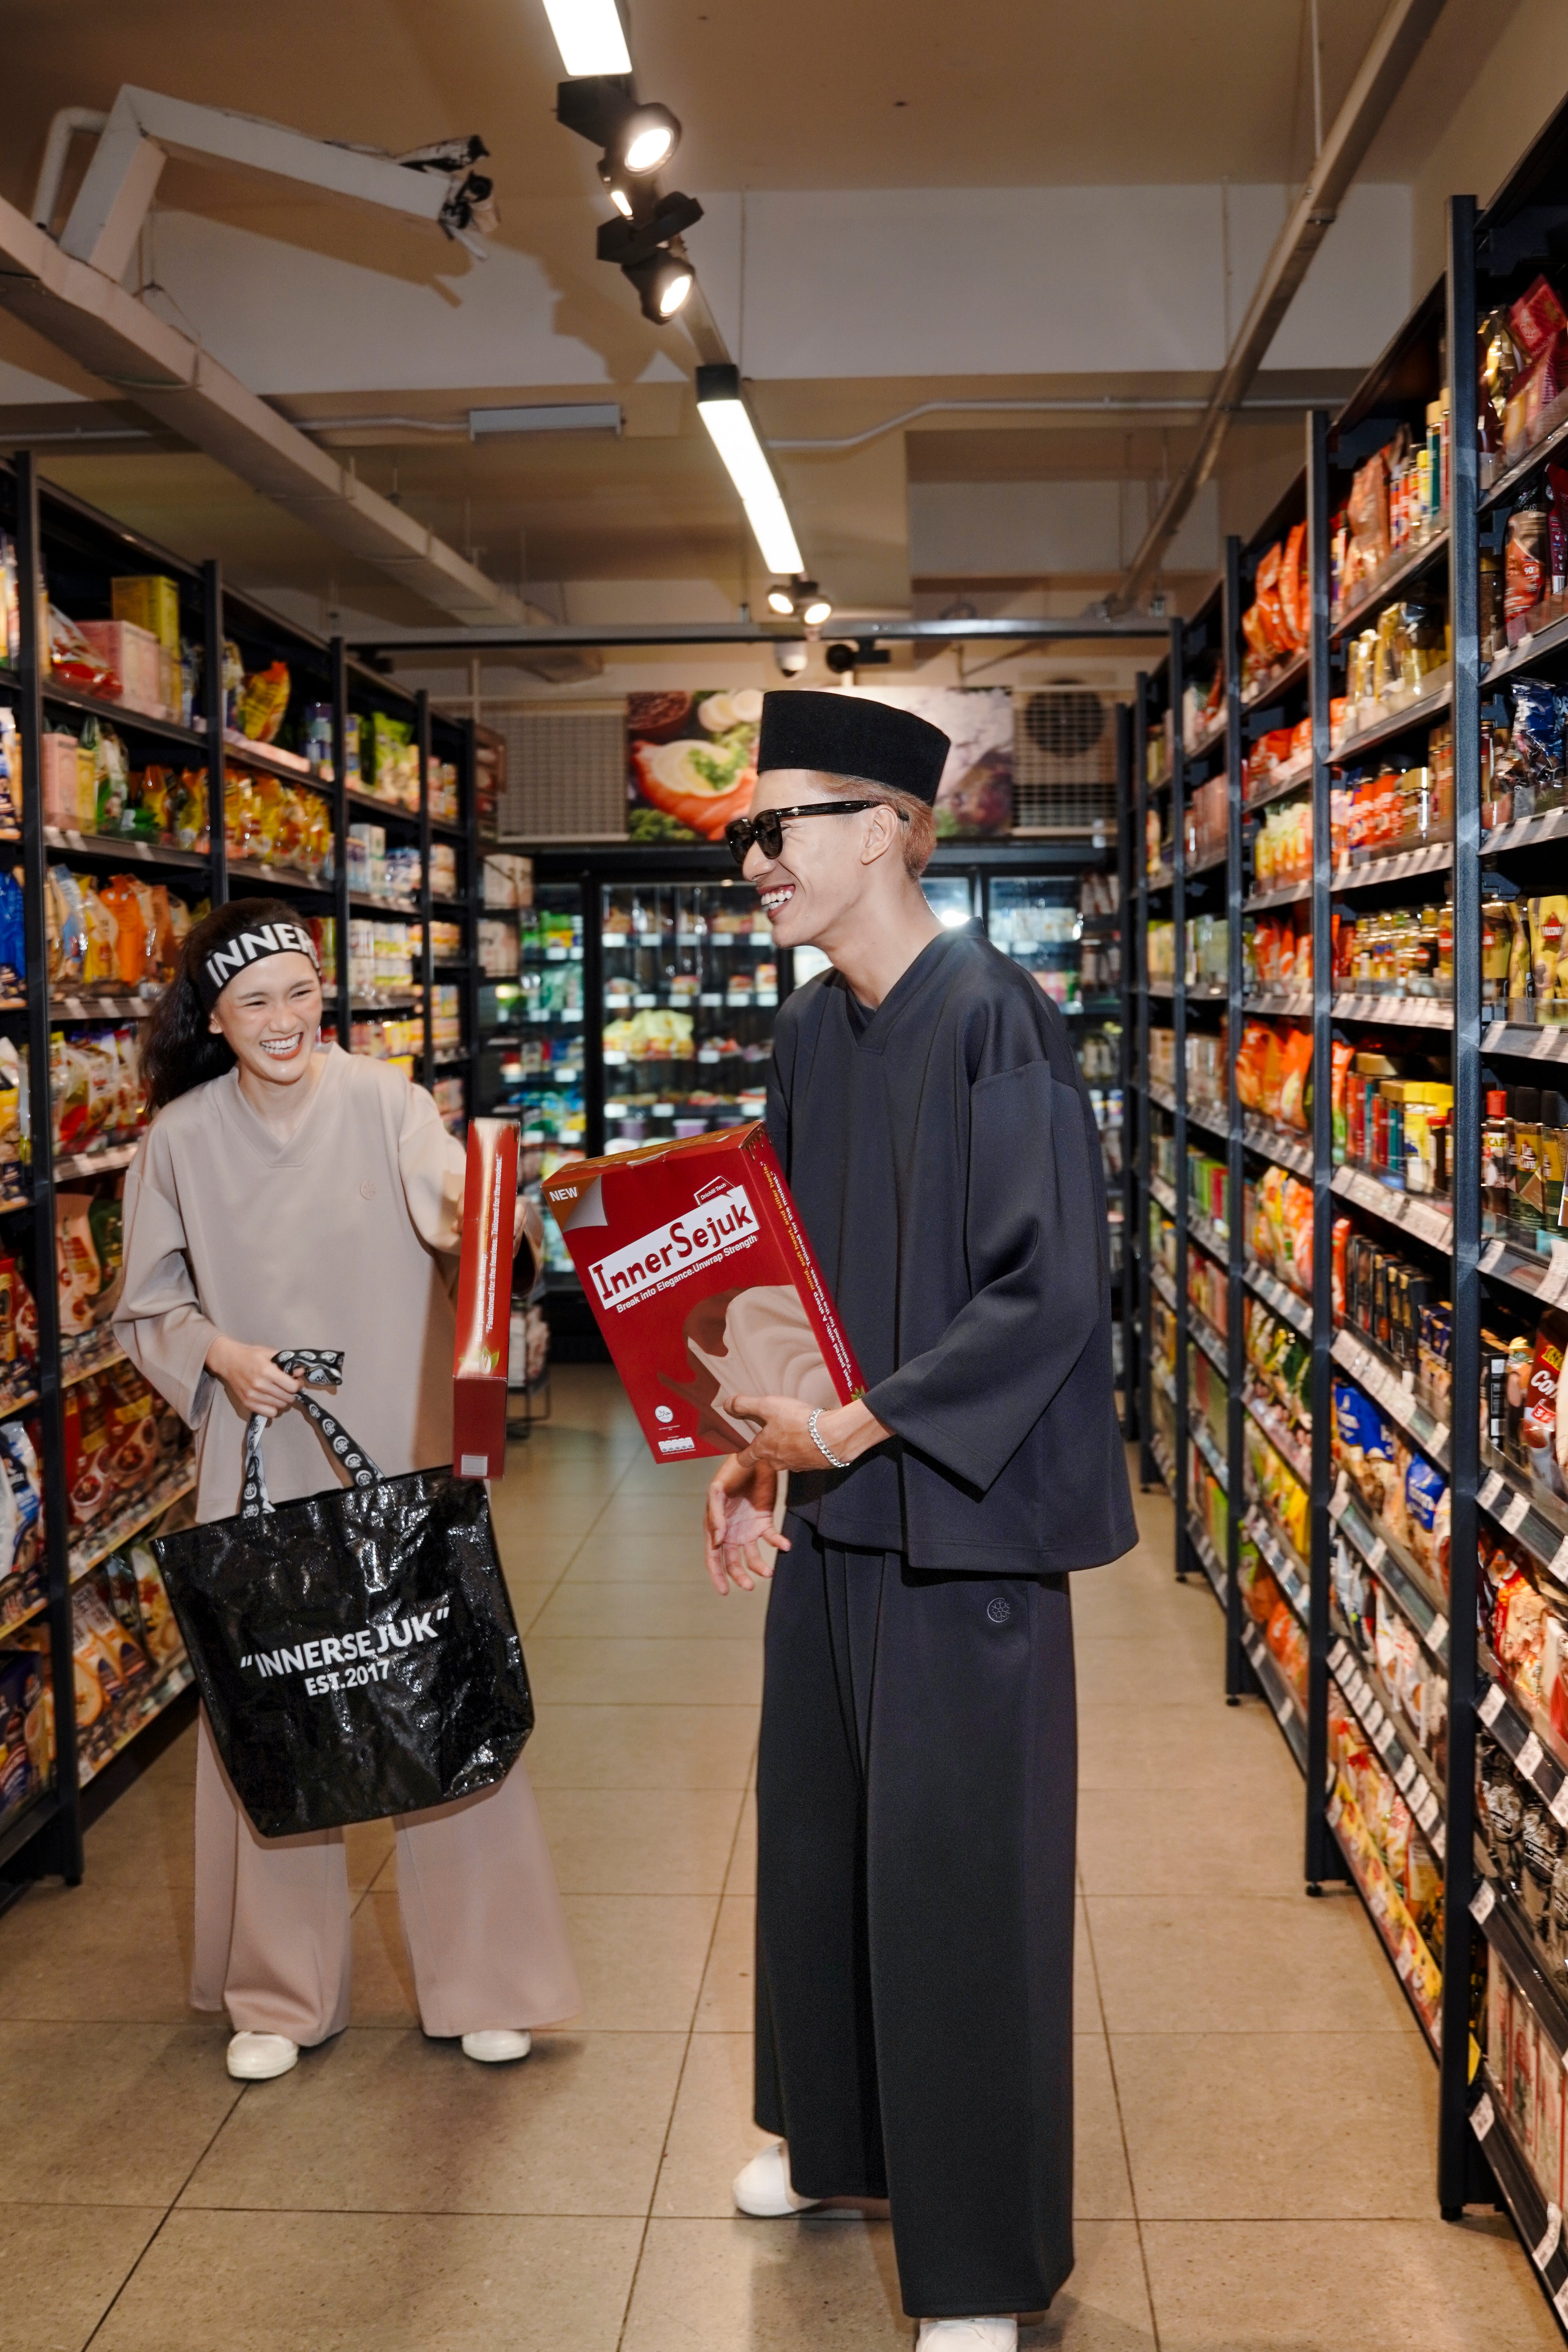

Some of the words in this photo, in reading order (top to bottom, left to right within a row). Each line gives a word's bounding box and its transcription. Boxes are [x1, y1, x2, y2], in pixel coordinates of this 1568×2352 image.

[206, 923, 321, 988] INNER
[493, 1153, 502, 1184] modest.”
[492, 1184, 501, 1196] the
[492, 1196, 500, 1207] for
[549, 1187, 578, 1202] NEW
[700, 1188, 716, 1200] Drichill
[715, 1183, 726, 1191] Tech
[772, 1190, 782, 1209] killer
[490, 1208, 499, 1236] Tailored
[780, 1210, 789, 1225] and
[788, 1227, 799, 1250] heart,
[489, 1236, 498, 1266] fearless.
[592, 1204, 753, 1301] InnerSejuk
[796, 1234, 810, 1267] Tailored
[797, 1251, 805, 1266] soft
[479, 1253, 488, 1274] sharp
[616, 1296, 640, 1313] Break
[640, 1288, 656, 1300] into
[723, 1235, 757, 1256] Strength
[488, 1280, 496, 1291] for
[804, 1268, 815, 1290] mind,
[811, 1267, 824, 1301] fearless.
[476, 1301, 486, 1324] paired
[486, 1292, 495, 1333] “Fashioned
[813, 1292, 824, 1314] sharp
[475, 1325, 483, 1345] “Best
[826, 1322, 835, 1343] with:
[833, 1328, 851, 1372] “Fashioned
[833, 1343, 846, 1368] paired
[843, 1369, 852, 1391] “Best
[240, 1607, 449, 1677] "INNERSEJUK"
[304, 1659, 390, 1696] EST.2017
